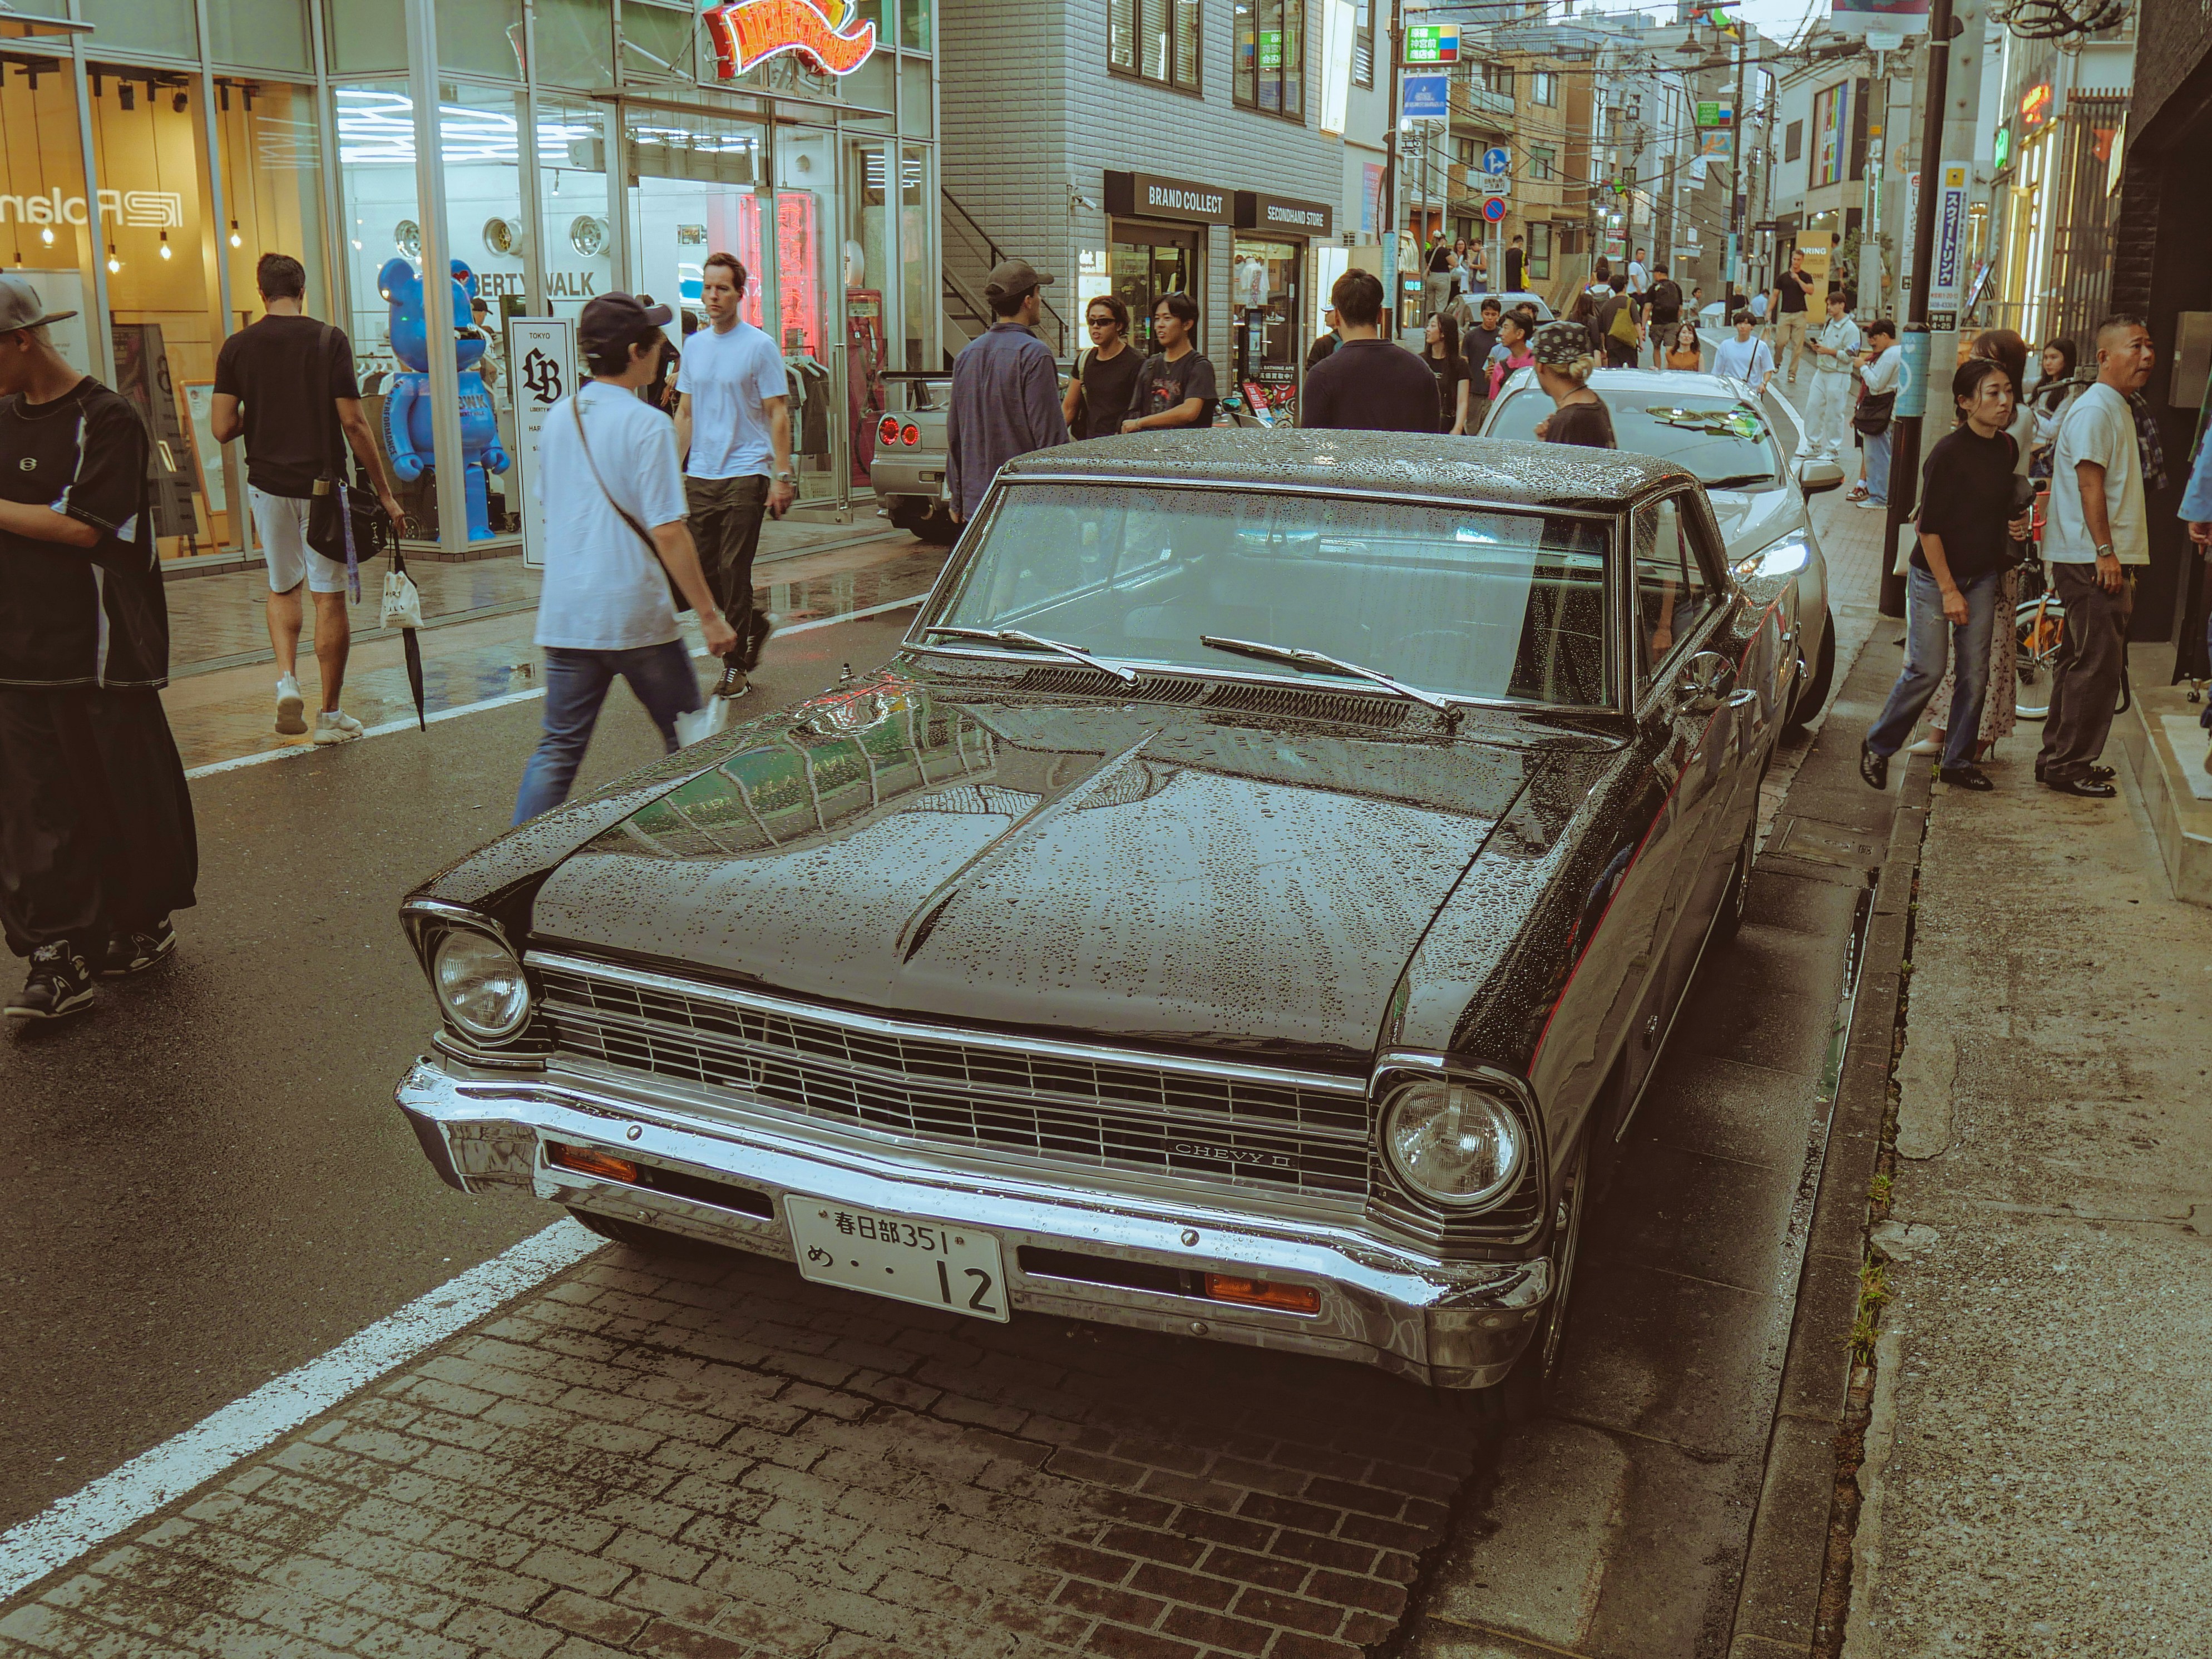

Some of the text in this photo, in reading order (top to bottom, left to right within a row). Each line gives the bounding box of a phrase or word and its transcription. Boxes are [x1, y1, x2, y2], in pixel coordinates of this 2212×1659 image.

[1410, 38, 1436, 48] 神宮前
[1410, 50, 1436, 59] 商店会
[1149, 186, 1223, 214] BRAND COLLECT
[1267, 205, 1324, 227] SECONDHAND STORE
[383, 397, 397, 457] PERFORMANCE
[1176, 1144, 1264, 1163] CHEVY
